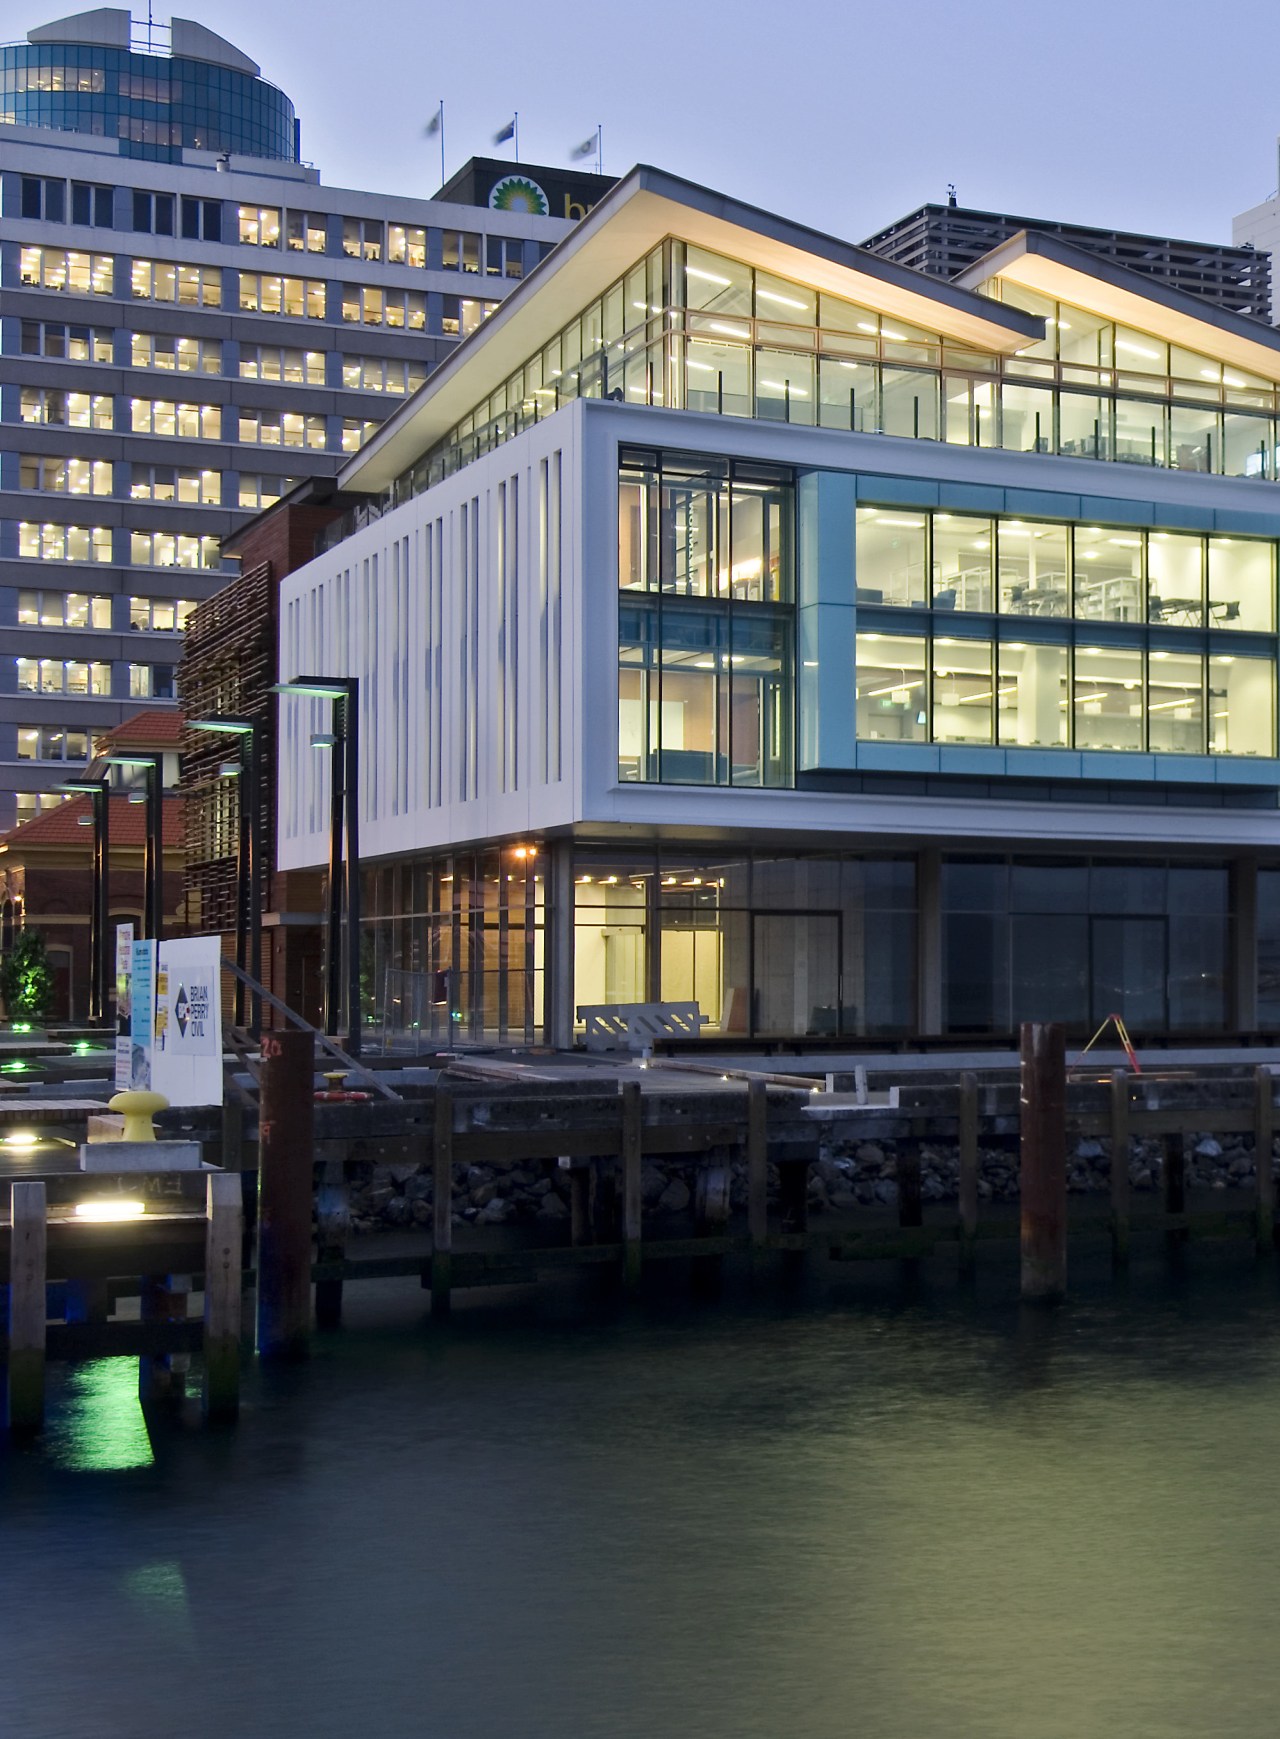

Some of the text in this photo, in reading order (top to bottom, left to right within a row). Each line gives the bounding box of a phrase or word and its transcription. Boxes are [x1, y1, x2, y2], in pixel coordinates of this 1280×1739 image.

[564, 193, 596, 220] b
[190, 986, 208, 1003] BRIAN
[191, 1004, 209, 1020] PERRY
[191, 1020, 205, 1037] CIVIL
